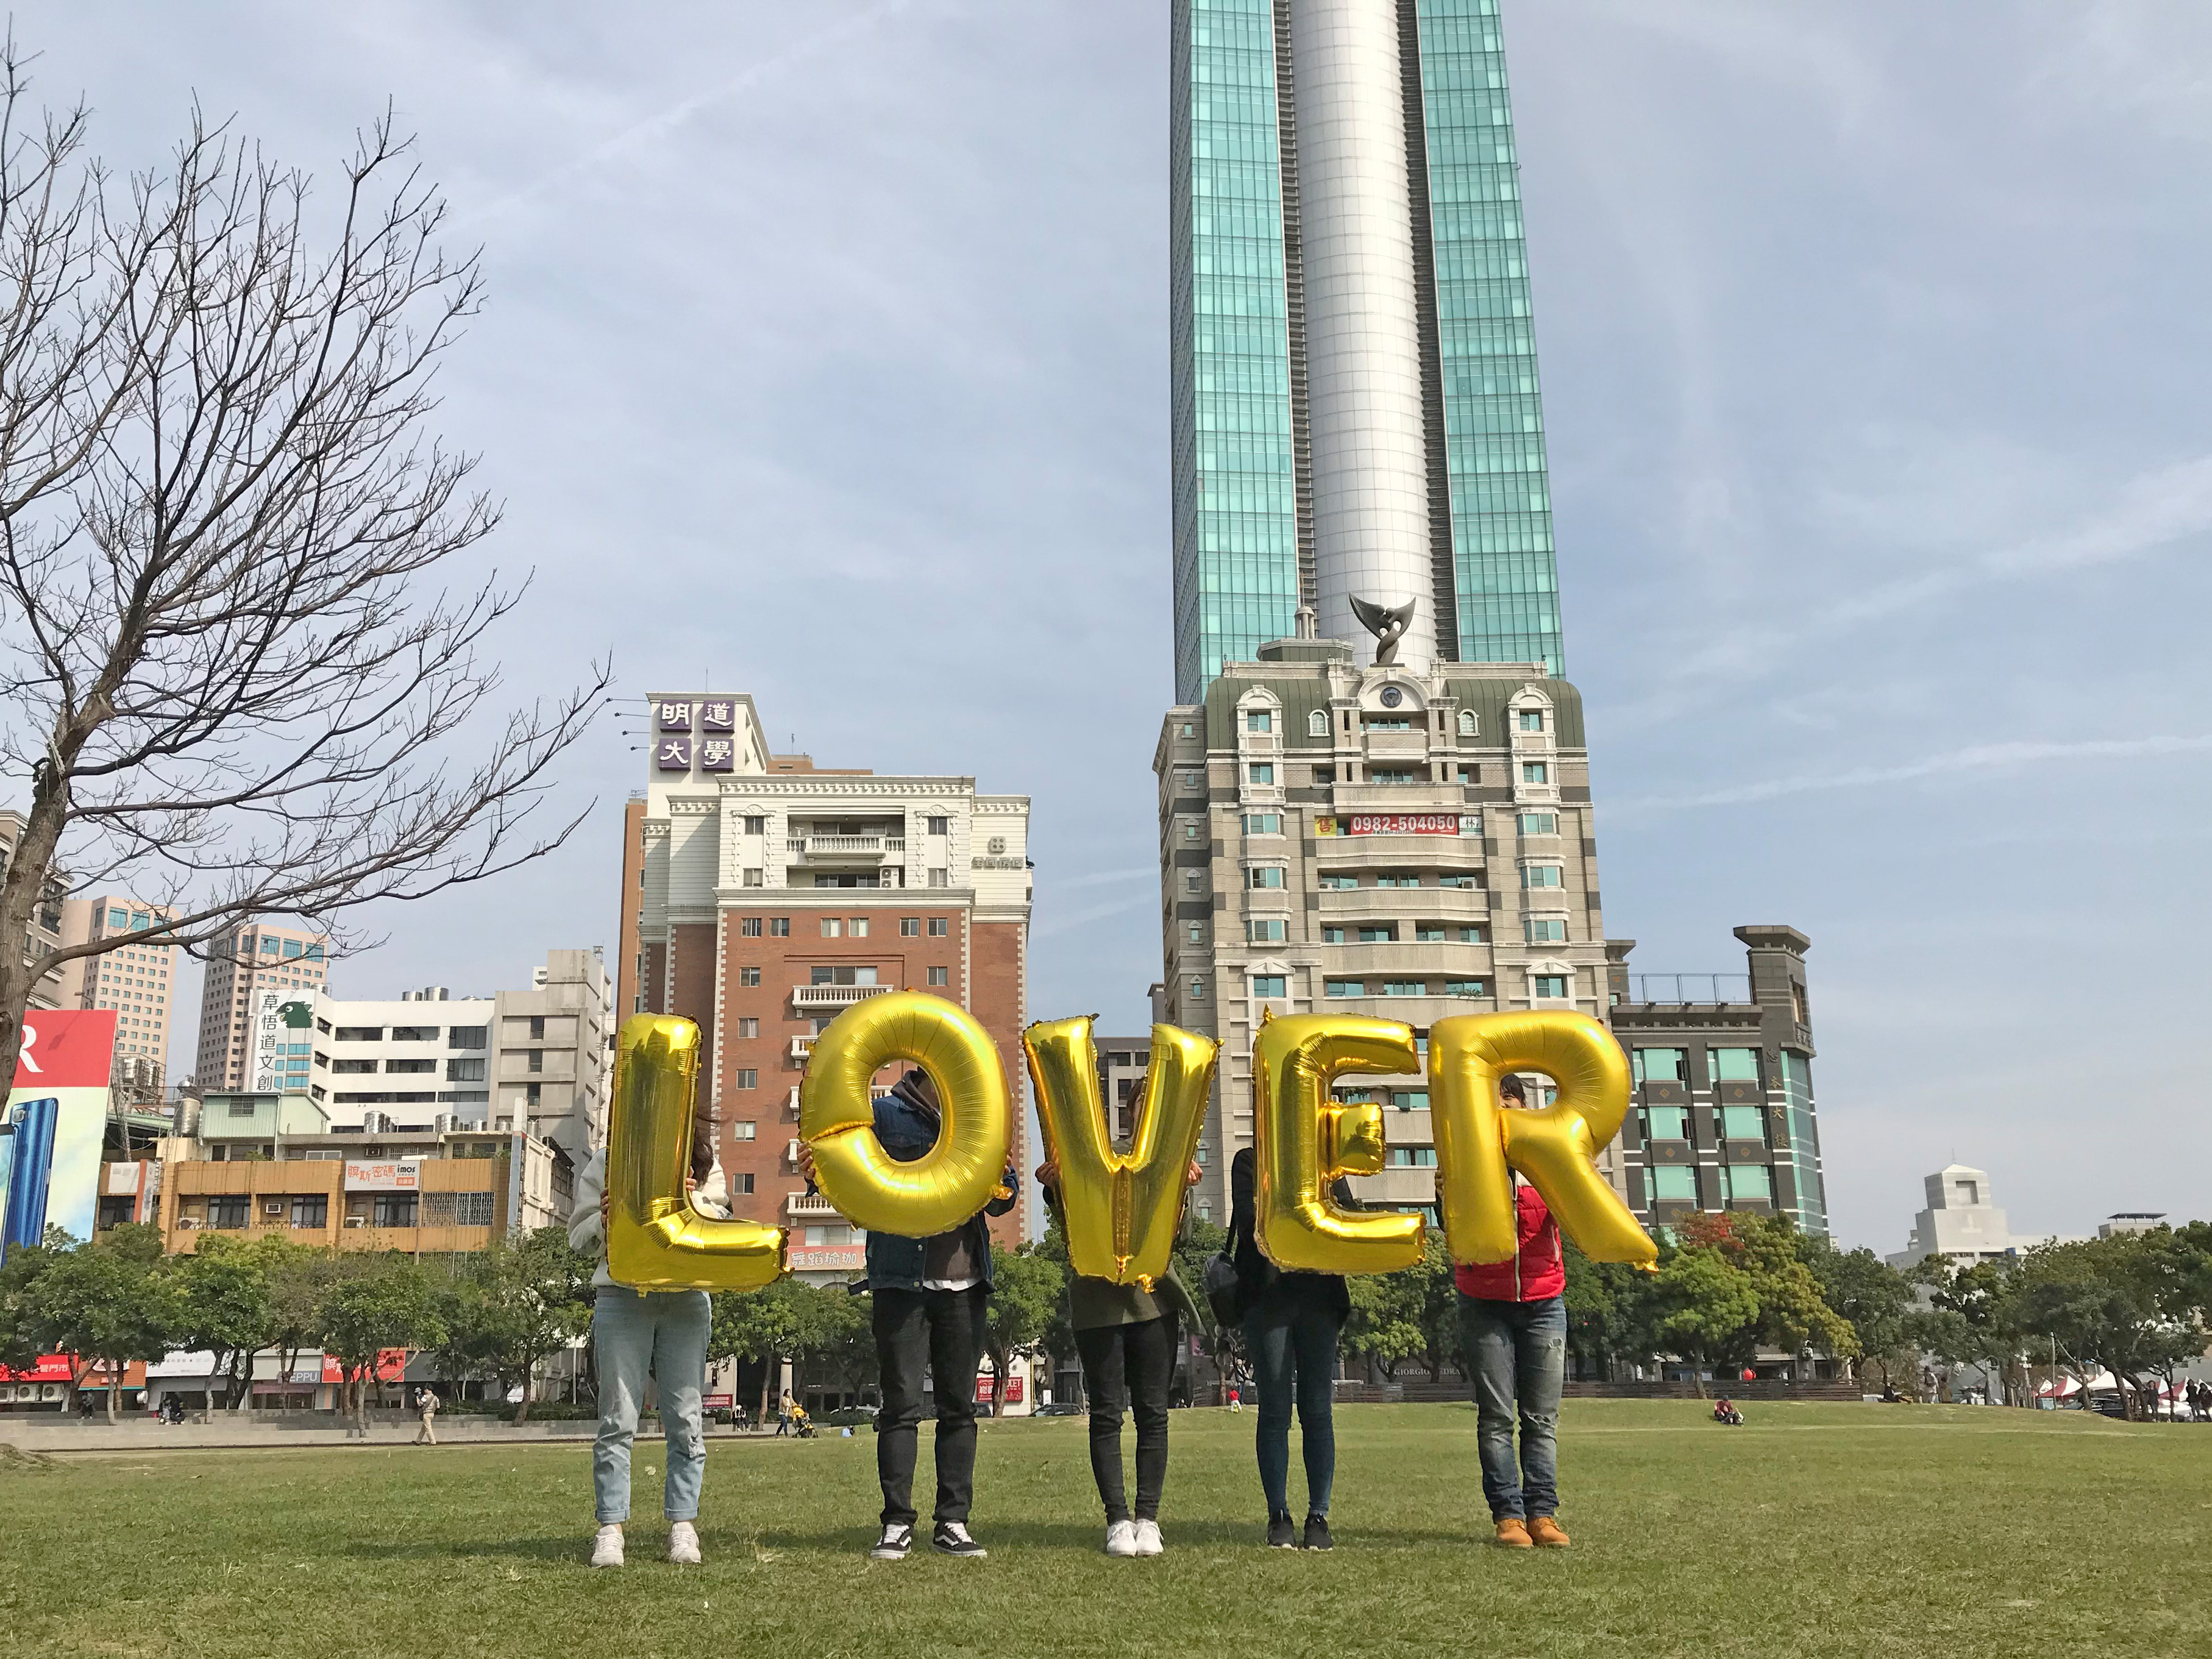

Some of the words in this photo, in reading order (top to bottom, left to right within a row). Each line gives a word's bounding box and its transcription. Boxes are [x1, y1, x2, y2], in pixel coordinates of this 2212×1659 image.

[661, 703, 733, 726] 明道
[660, 741, 731, 766] 大學
[1317, 817, 1333, 833] 售
[1353, 815, 1456, 831] 0982-504050
[257, 994, 279, 1091] 草悟道文創
[605, 990, 1659, 1295] LOVER
